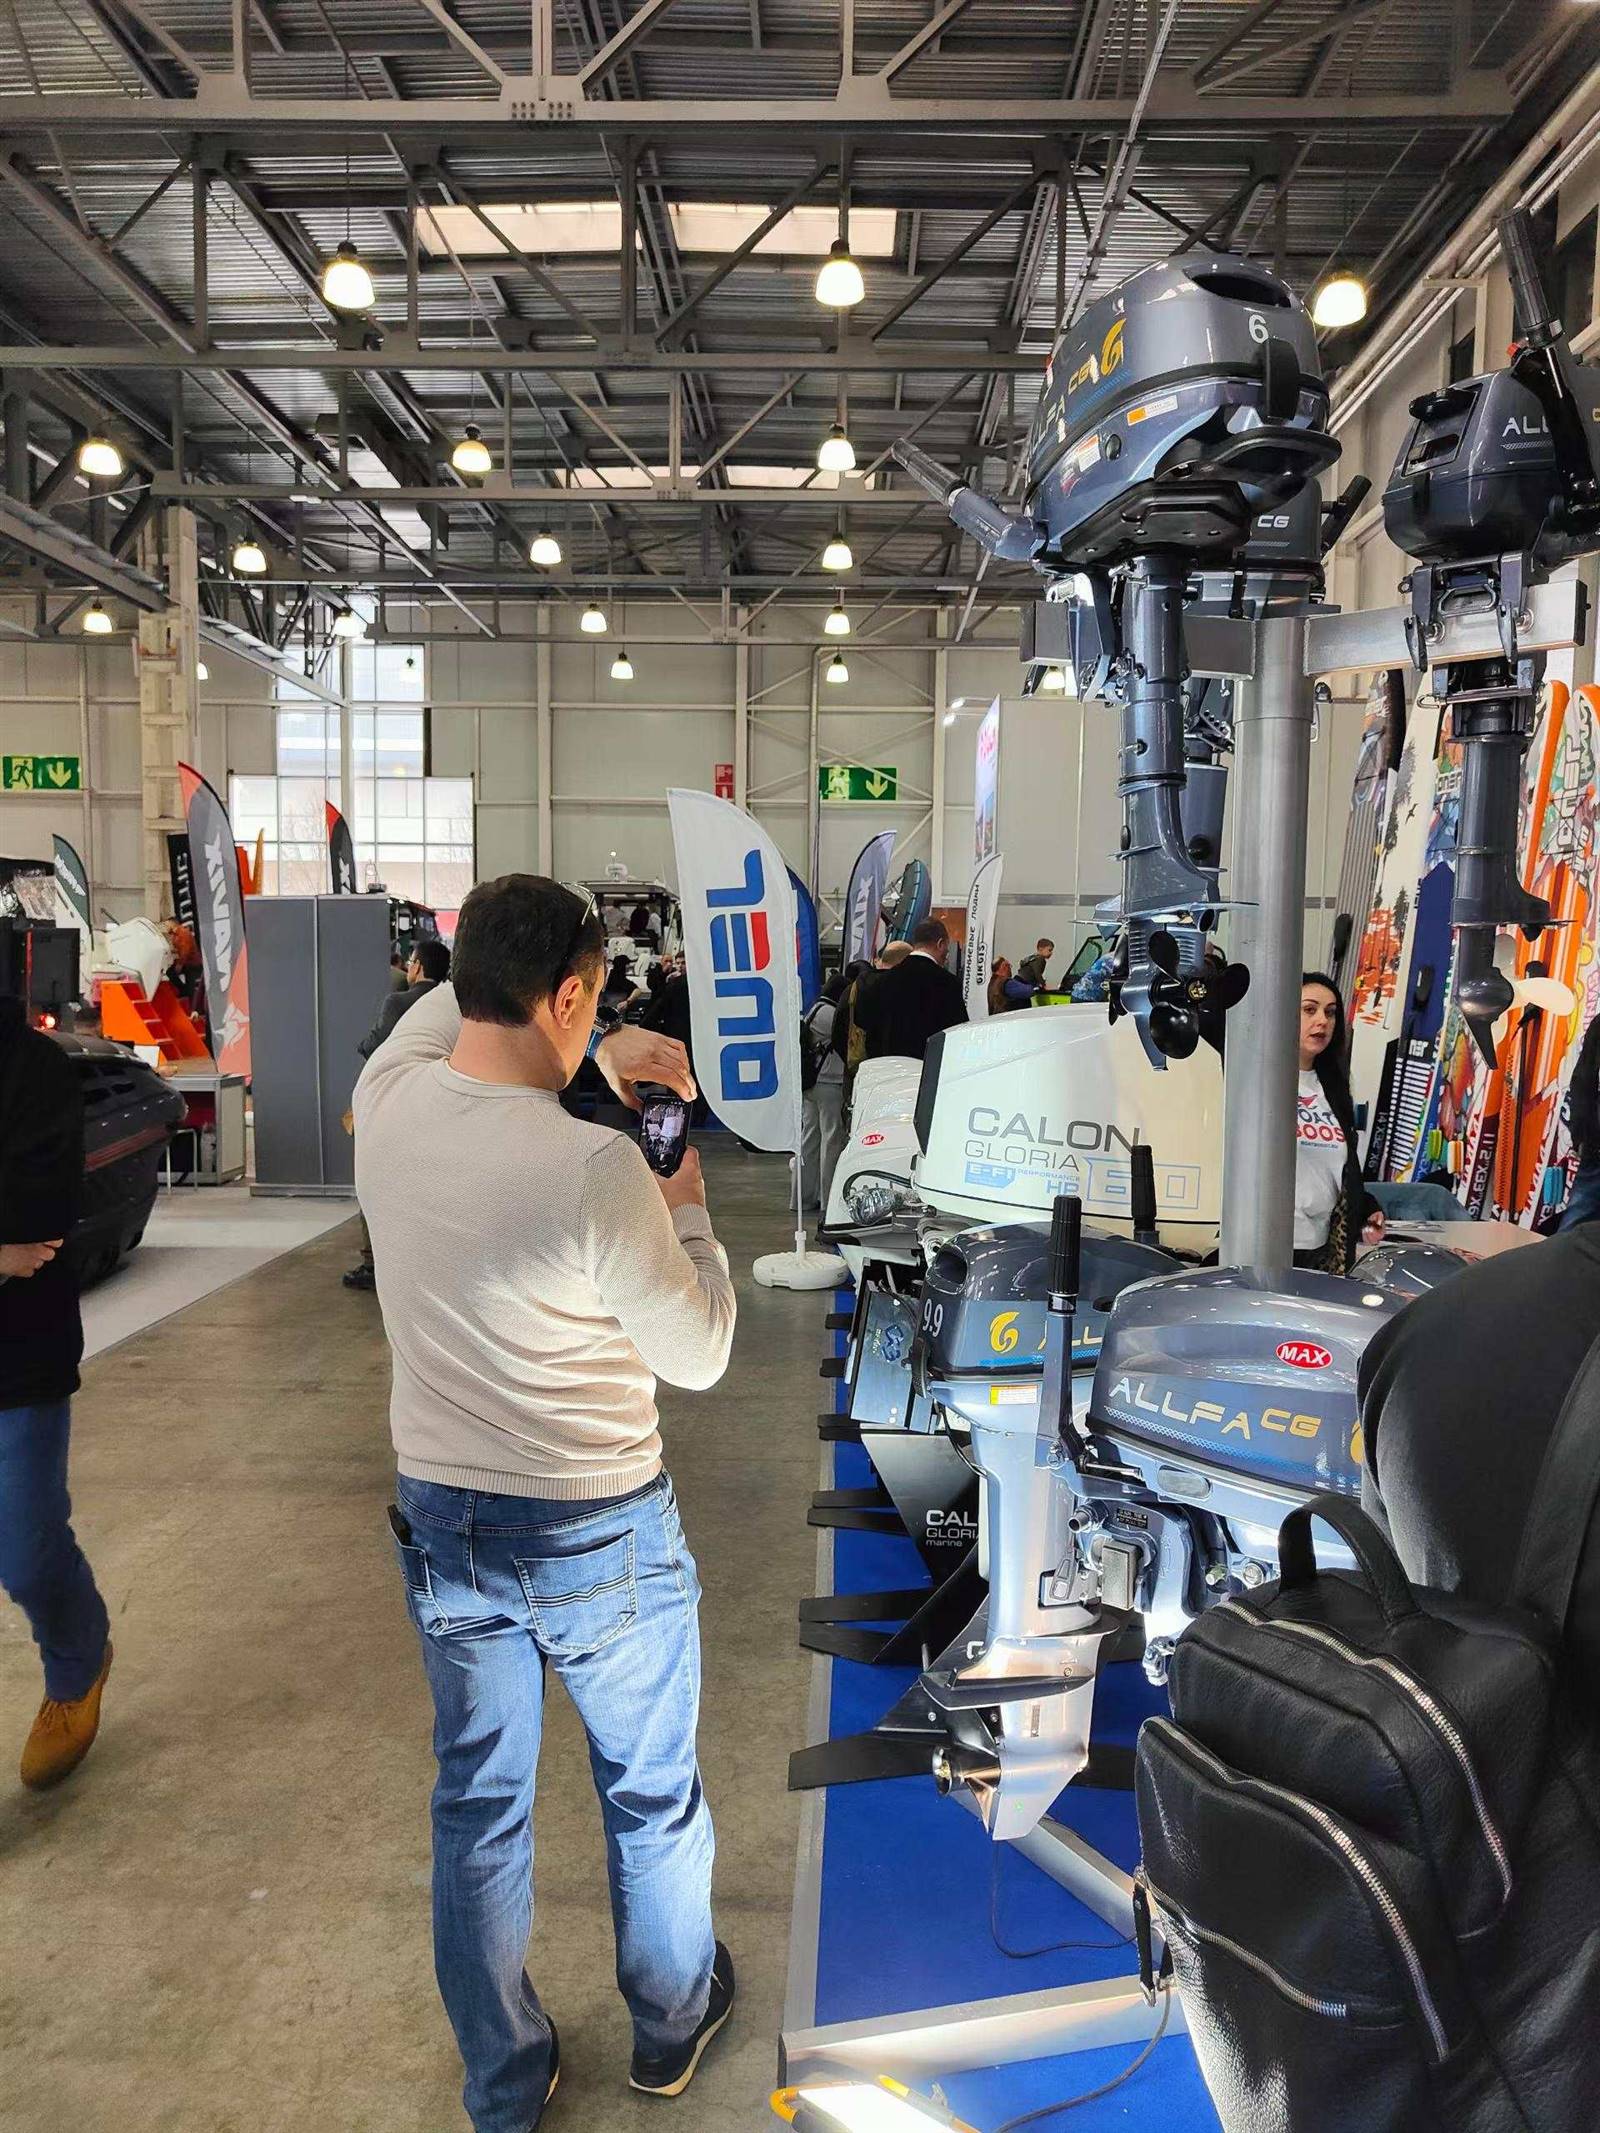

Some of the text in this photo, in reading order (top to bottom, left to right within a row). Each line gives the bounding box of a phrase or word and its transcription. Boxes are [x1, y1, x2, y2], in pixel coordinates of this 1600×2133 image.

[1248, 314, 1269, 344] 6
[1257, 515, 1290, 528] CG
[968, 1106, 1140, 1152] CALON
[1296, 1108, 1334, 1126] OAT
[965, 1139, 1080, 1172] GLORIA
[922, 1298, 944, 1338] 9.9
[1280, 1345, 1328, 1366] MAX
[1108, 1377, 1321, 1440] ALLFA CG
[925, 1528, 979, 1540] GLORI
